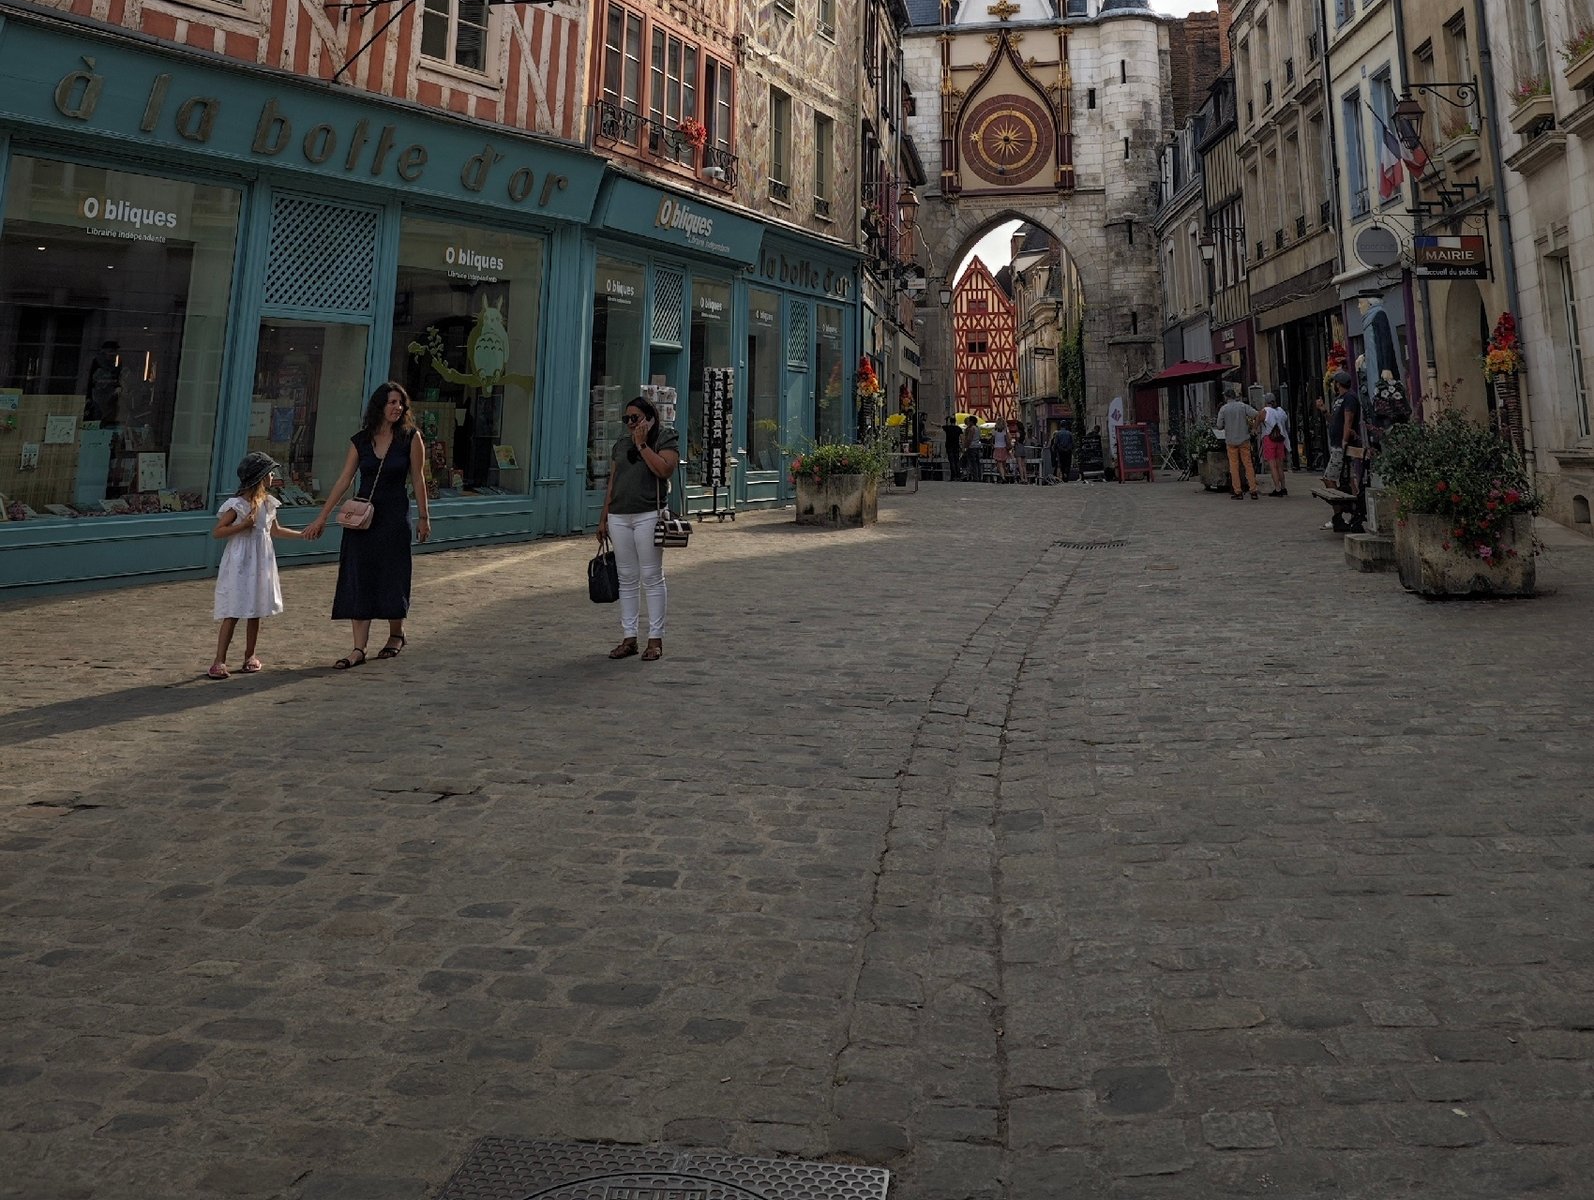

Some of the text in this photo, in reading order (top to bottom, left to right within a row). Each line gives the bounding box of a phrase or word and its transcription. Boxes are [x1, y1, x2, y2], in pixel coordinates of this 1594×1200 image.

[53, 56, 569, 207] à la botte d'or
[1425, 250, 1475, 261] MAIRIE
[1448, 267, 1458, 276] du
[1458, 267, 1479, 276] public
